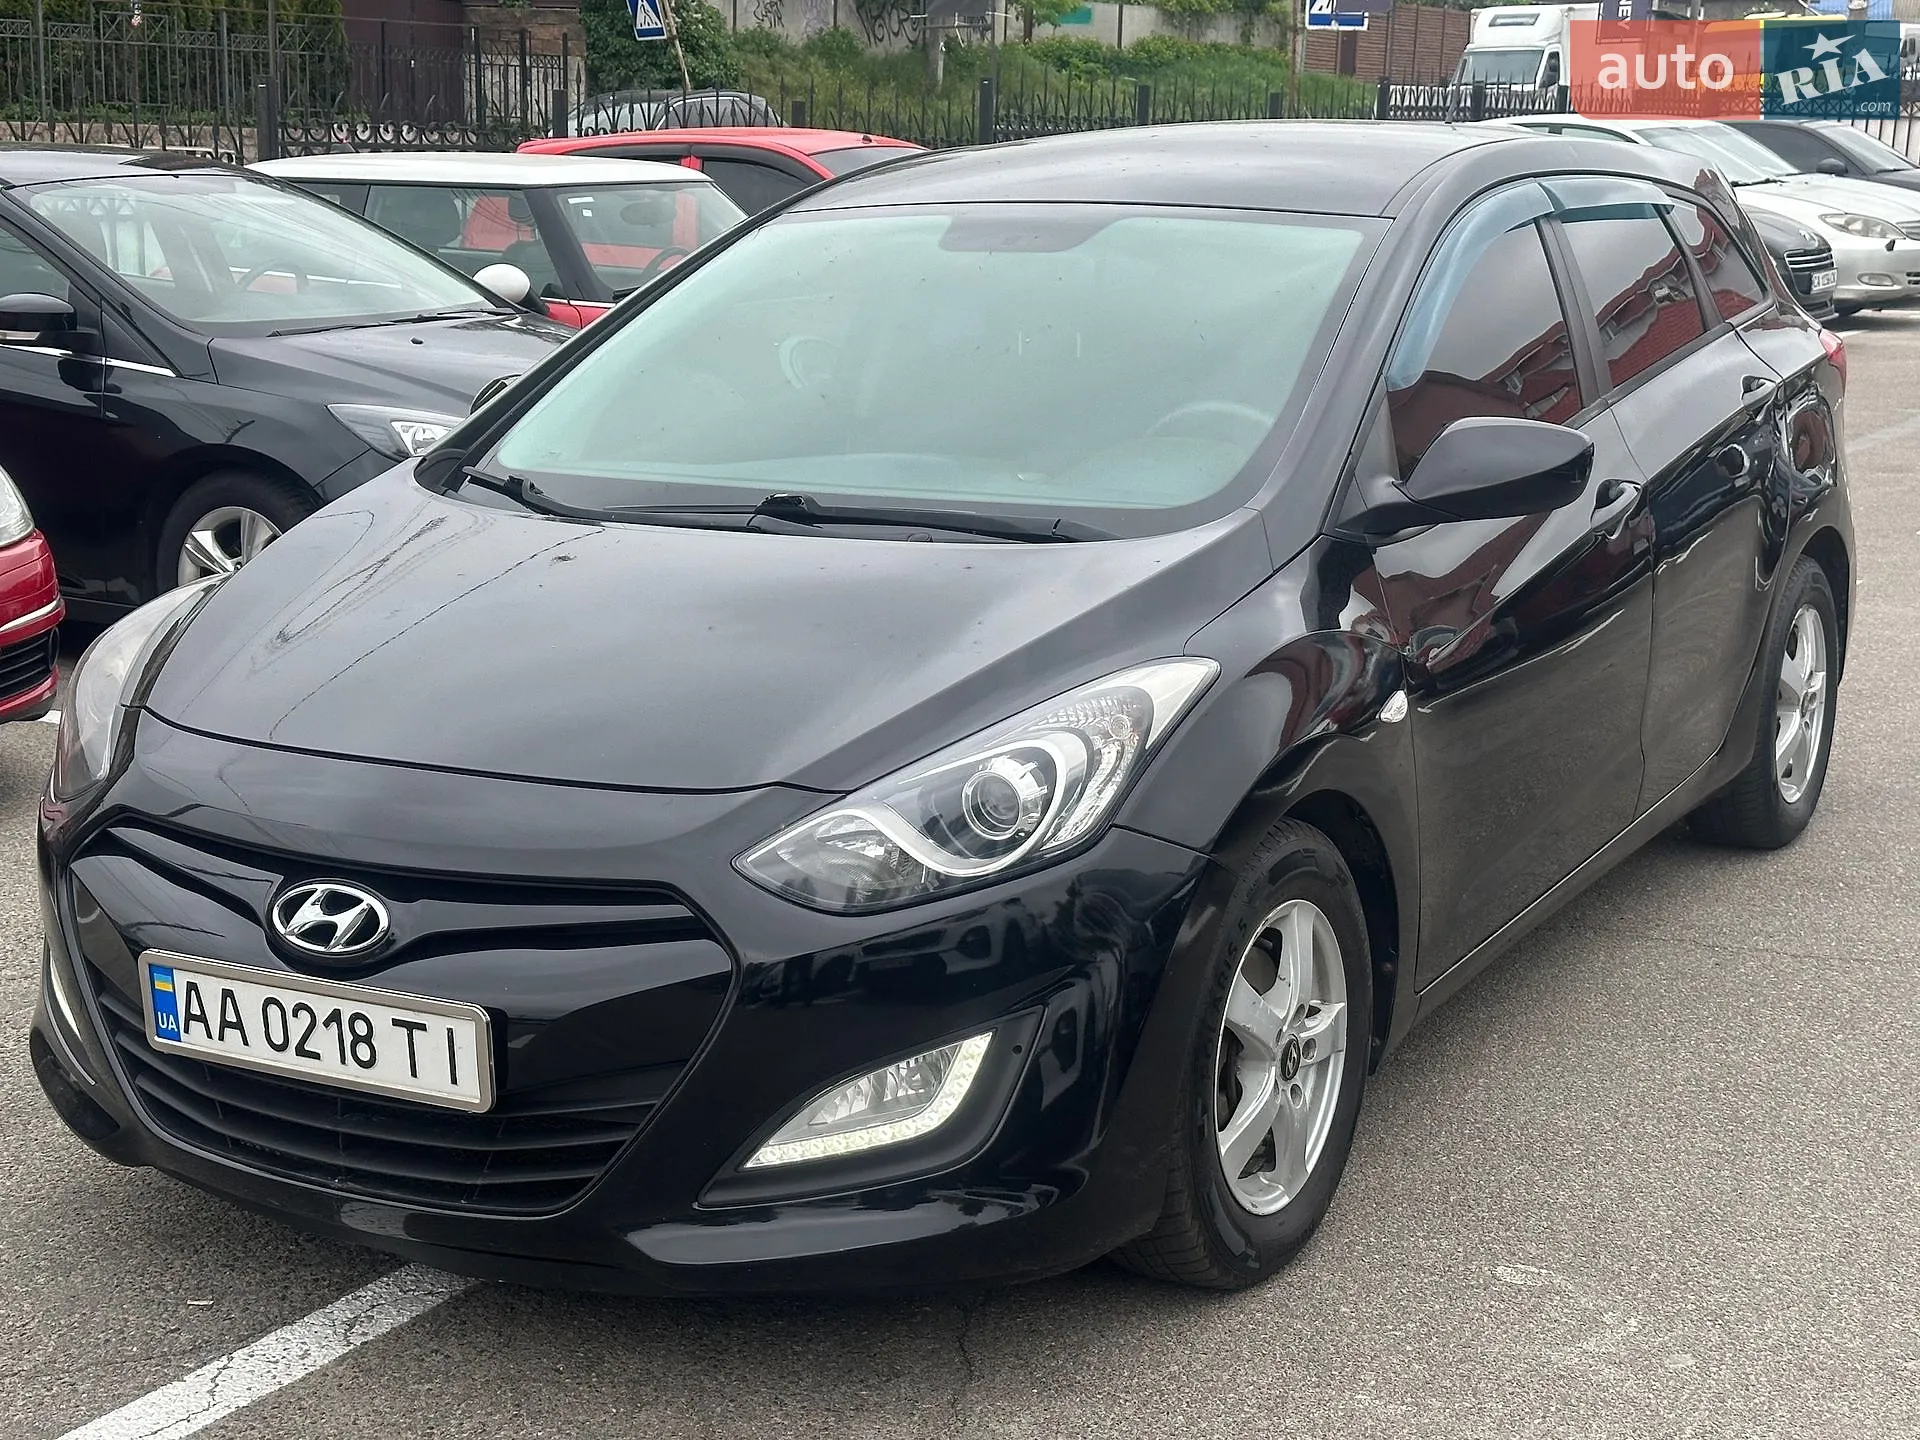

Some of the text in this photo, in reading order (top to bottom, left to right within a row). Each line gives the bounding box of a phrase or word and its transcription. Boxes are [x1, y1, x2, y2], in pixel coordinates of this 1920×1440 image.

[158, 1011, 178, 1032] UA
[183, 980, 250, 1047] AA
[261, 996, 378, 1069] 0218
